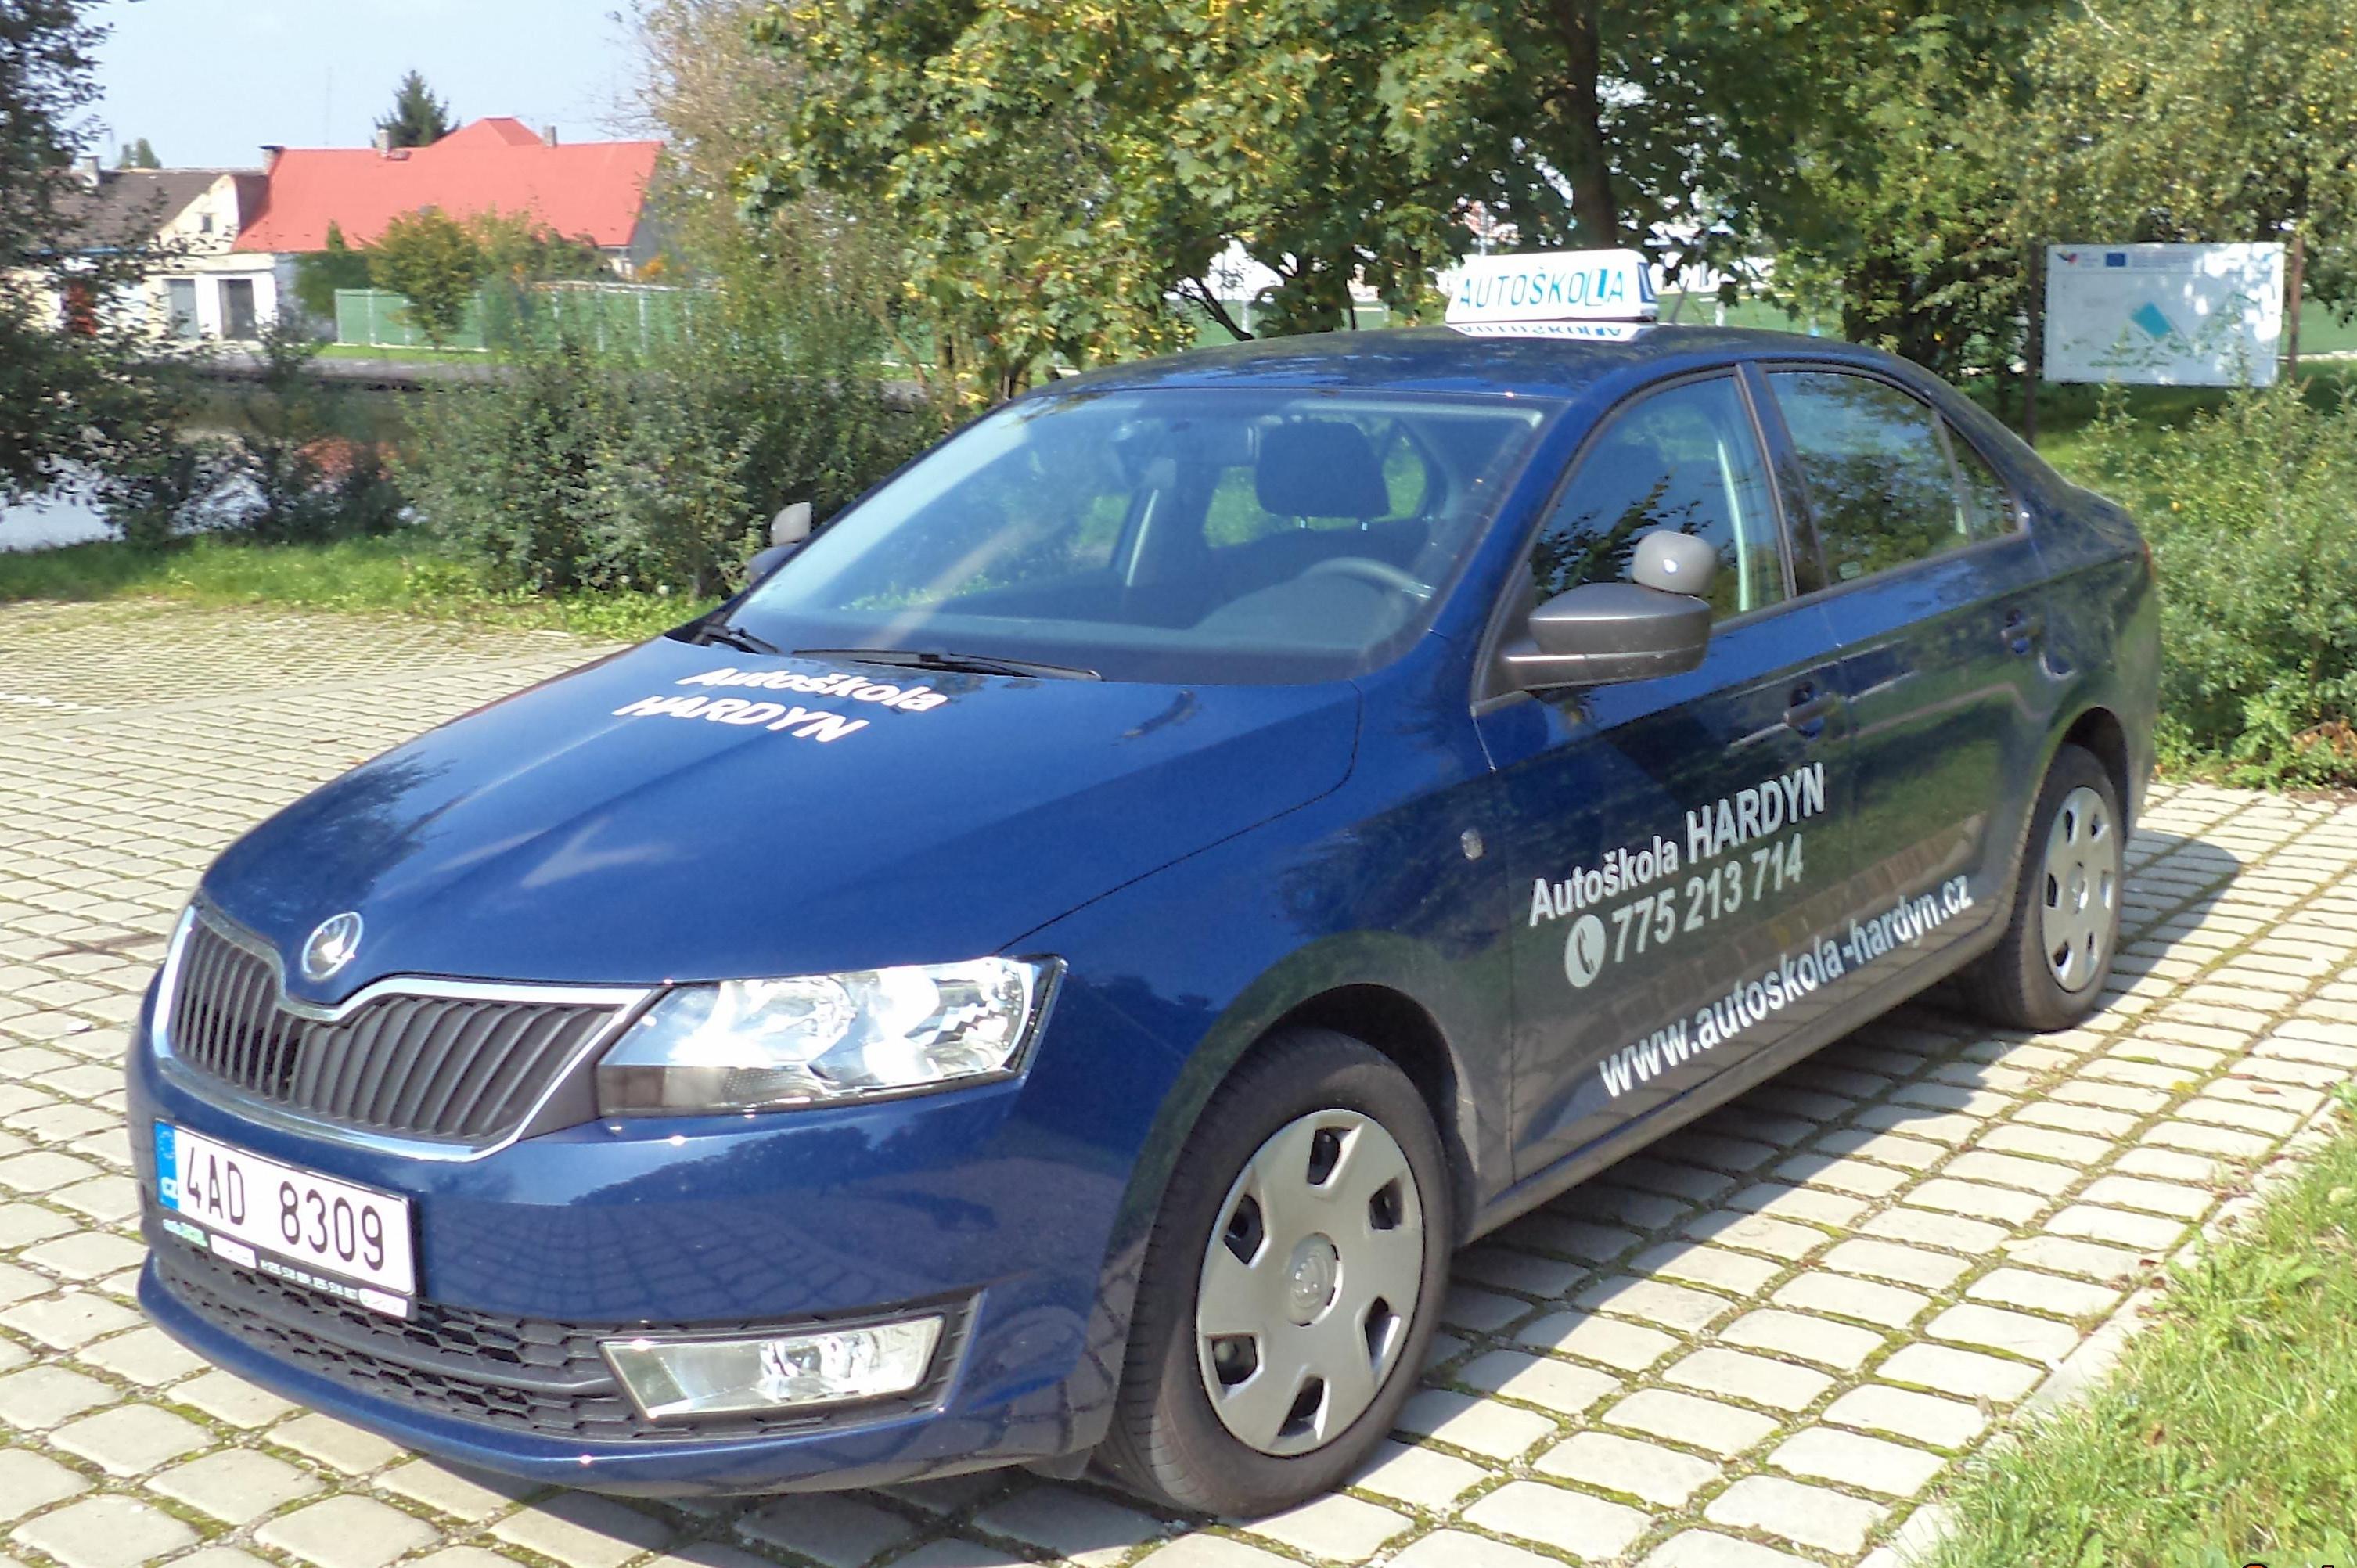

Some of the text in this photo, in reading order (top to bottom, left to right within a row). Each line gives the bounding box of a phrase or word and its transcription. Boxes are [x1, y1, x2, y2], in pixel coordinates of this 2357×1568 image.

[1459, 267, 1623, 307] AUTOŠKOLA
[612, 696, 870, 743] HARDYN
[677, 667, 949, 712] Autoškola
[1530, 762, 1826, 926] Autoškola HARDYN
[1610, 833, 1804, 963] 775 213 714
[1599, 874, 1974, 1098] www.autoskola-hardyn.cz
[188, 1147, 246, 1226] 4AD
[279, 1181, 383, 1271] 8309
